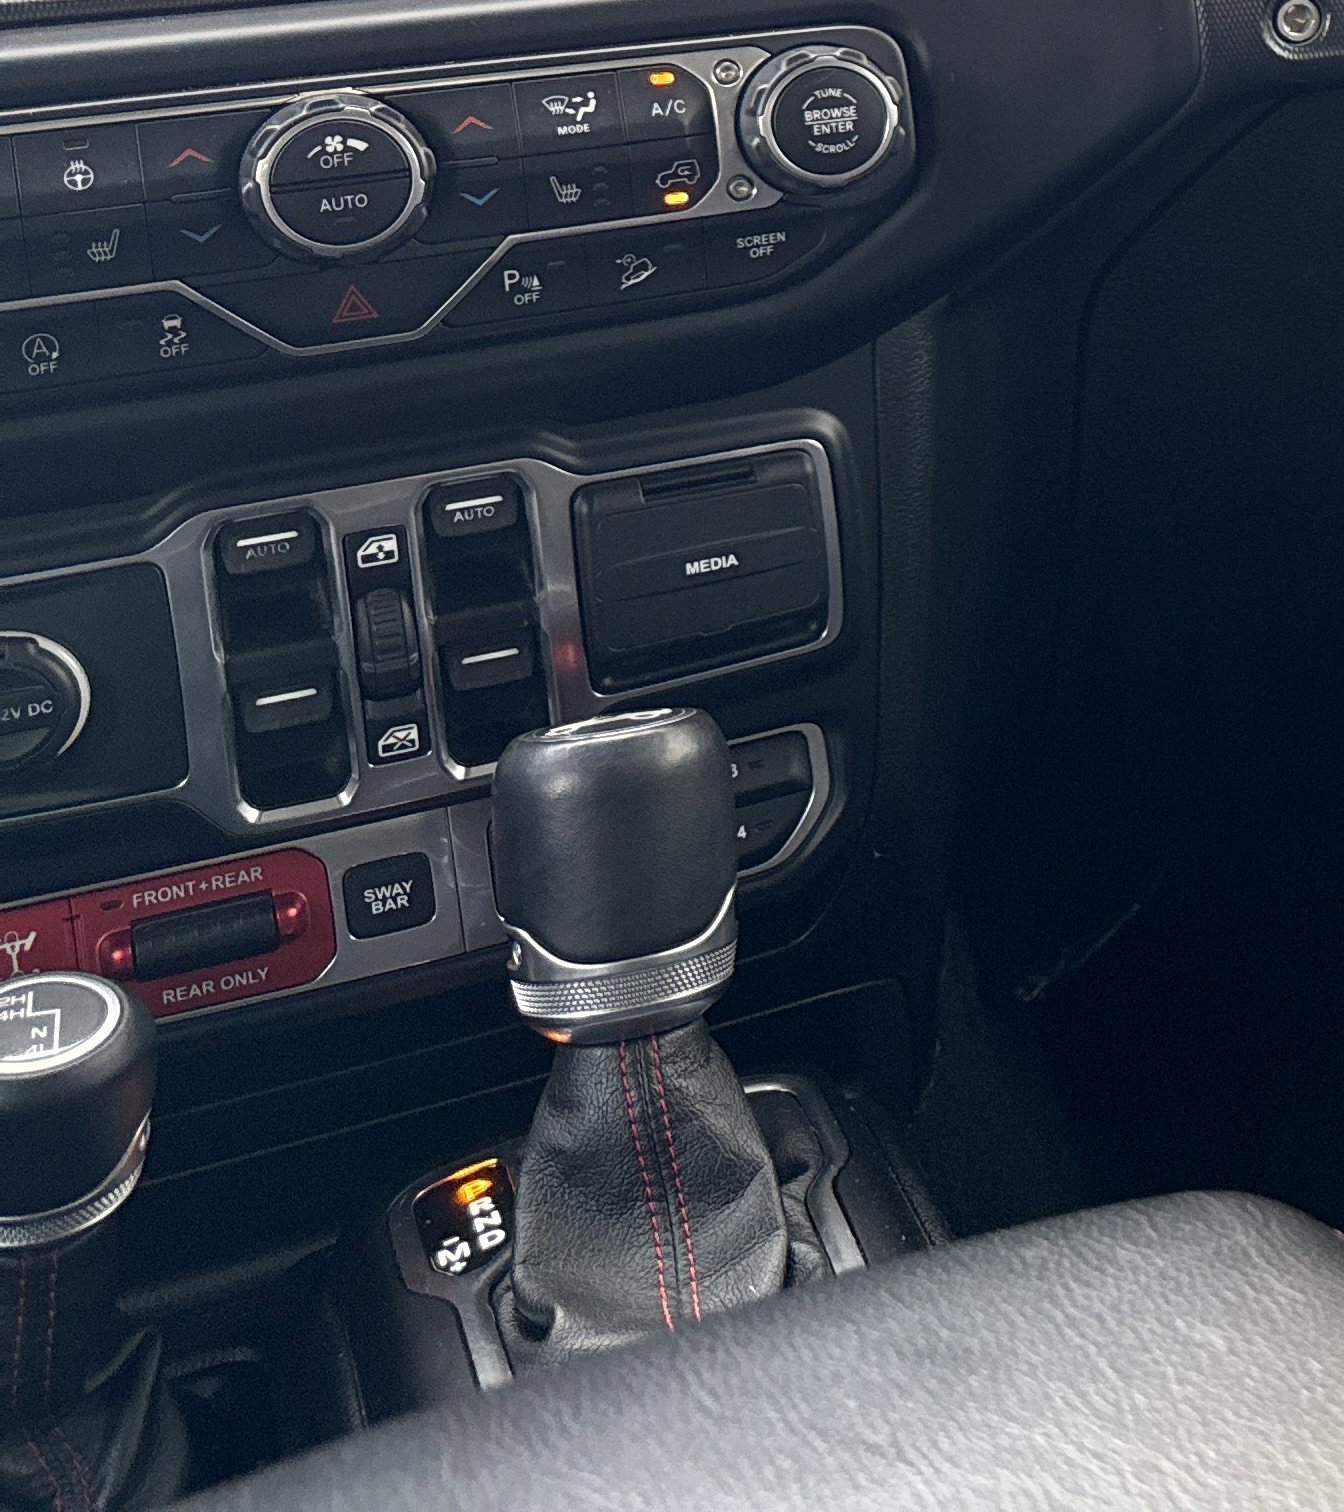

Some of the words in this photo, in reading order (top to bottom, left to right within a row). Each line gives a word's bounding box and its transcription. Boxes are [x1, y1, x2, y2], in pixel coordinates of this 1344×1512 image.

[813, 88, 843, 99] TUNE
[651, 99, 687, 117] A/C
[804, 106, 858, 122] BROWSE
[557, 123, 591, 136] MODE
[813, 121, 855, 136] ENTER
[815, 140, 856, 154] SCROLL
[319, 152, 354, 170] OFF
[319, 193, 368, 214] AUTO
[736, 231, 787, 249] SCREEN
[749, 244, 775, 259] OFF
[513, 292, 541, 306] OFF
[160, 343, 190, 358] OFF
[28, 361, 59, 377] OFF
[452, 506, 496, 524] AUTO
[245, 540, 291, 561] AUTO
[685, 553, 739, 576] MEDIA
[28, 699, 54, 717] DC
[730, 763, 739, 778] 3
[737, 825, 748, 839] 4
[363, 879, 413, 903] SWAY
[372, 895, 410, 915] BAR
[162, 980, 215, 1005] REAR
[220, 967, 270, 989] ONLY
[31, 1026, 47, 1039] N
[460, 1179, 493, 1202] P
[469, 1196, 495, 1216] R
[474, 1210, 502, 1233] N
[478, 1229, 506, 1250] D
[437, 1241, 471, 1267] M
